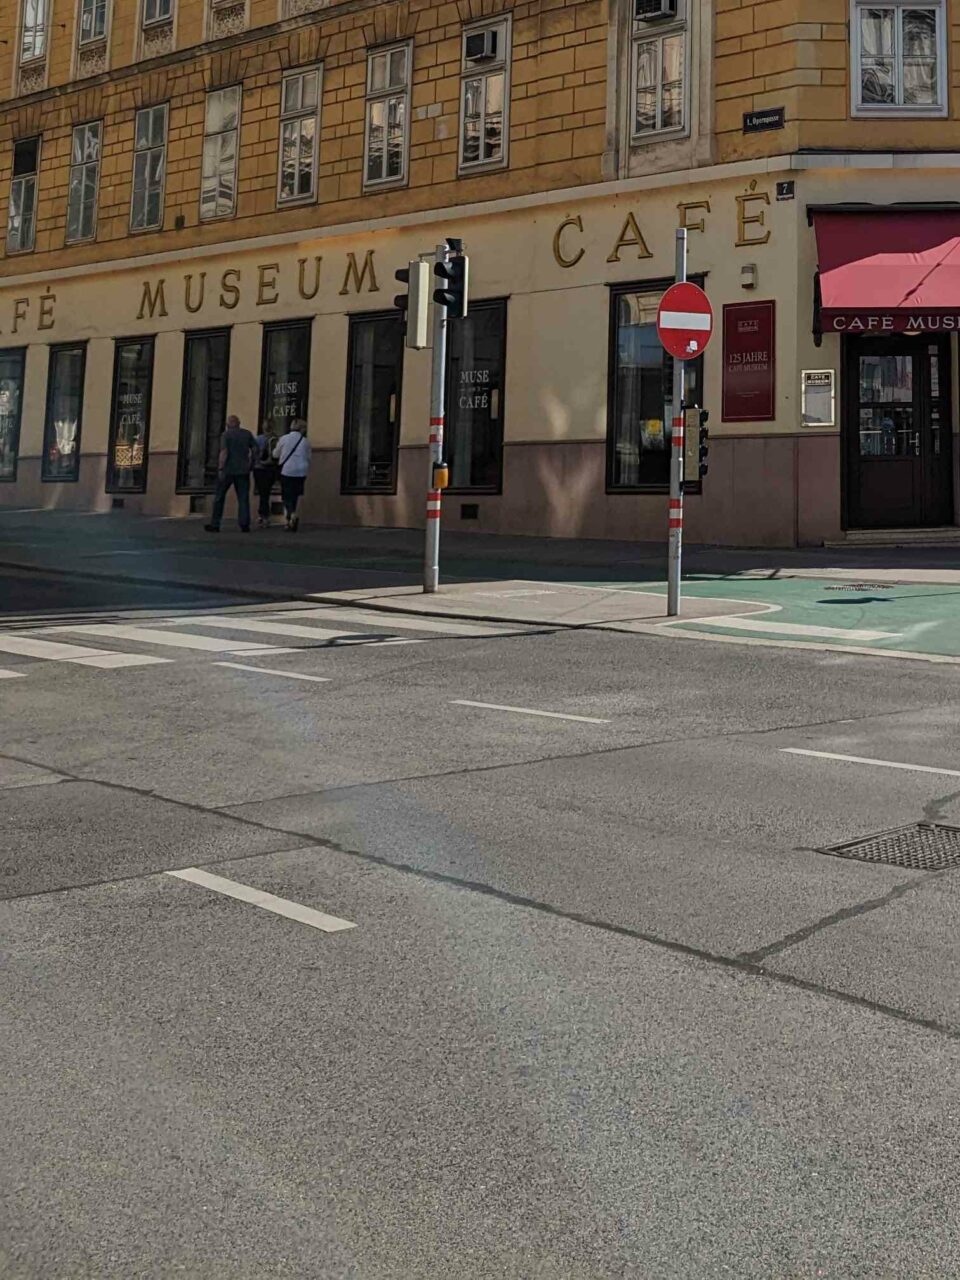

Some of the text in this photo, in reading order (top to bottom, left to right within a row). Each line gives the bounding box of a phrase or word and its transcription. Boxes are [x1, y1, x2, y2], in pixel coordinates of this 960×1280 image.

[782, 183, 788, 193] 7
[552, 179, 771, 268] CAFÉ
[0, 249, 380, 334] FÉ MUSEUM
[833, 314, 894, 330] CAFÉ
[729, 351, 768, 364] 125 JAHRE
[460, 370, 489, 383] MUSE
[273, 381, 298, 395] MUSE
[122, 392, 143, 404] MUSE
[459, 392, 489, 409] CAFÉ
[272, 401, 297, 417] CAFÉ
[121, 411, 142, 425] CAFÉ
